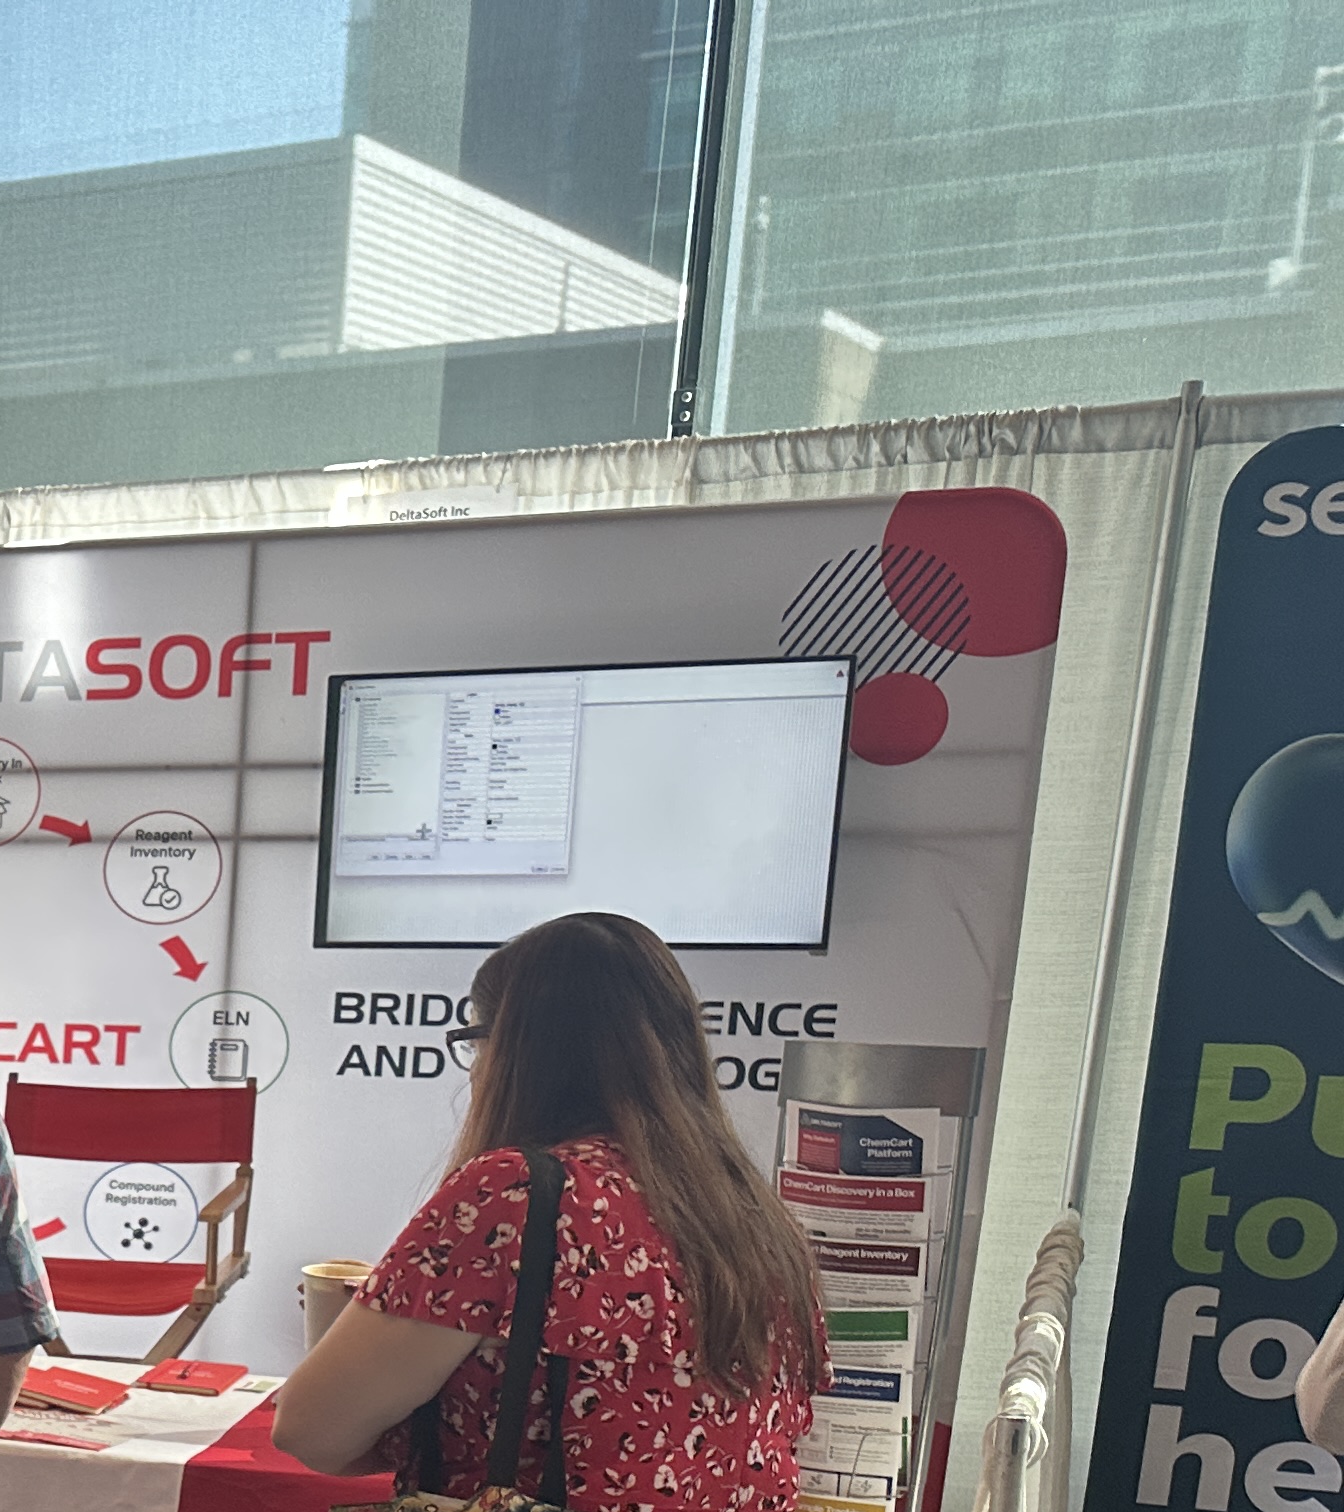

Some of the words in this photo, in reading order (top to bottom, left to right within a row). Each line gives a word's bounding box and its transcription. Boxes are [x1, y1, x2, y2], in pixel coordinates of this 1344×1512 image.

[389, 506, 448, 521] DeltaSoft
[451, 506, 470, 516] Inc
[12, 758, 23, 769] In
[135, 829, 193, 843] Reagent
[130, 846, 197, 860] Inventory
[212, 1010, 250, 1027] ELN
[698, 1001, 839, 1038] ENCE
[336, 1045, 446, 1079] AND
[859, 1137, 913, 1147] ChemCart
[867, 1149, 913, 1158] Platform
[109, 1179, 175, 1193] Compound
[783, 1177, 826, 1192] ChemCart
[826, 1183, 875, 1198] Discovery
[876, 1188, 886, 1197] in
[895, 1187, 915, 1198] Box
[105, 1193, 177, 1207] Registration
[1172, 1167, 1338, 1280] to
[820, 1245, 860, 1259] Reagent
[860, 1249, 909, 1261] Inventory
[1153, 1285, 1318, 1400] fo
[843, 1376, 894, 1389] Registration
